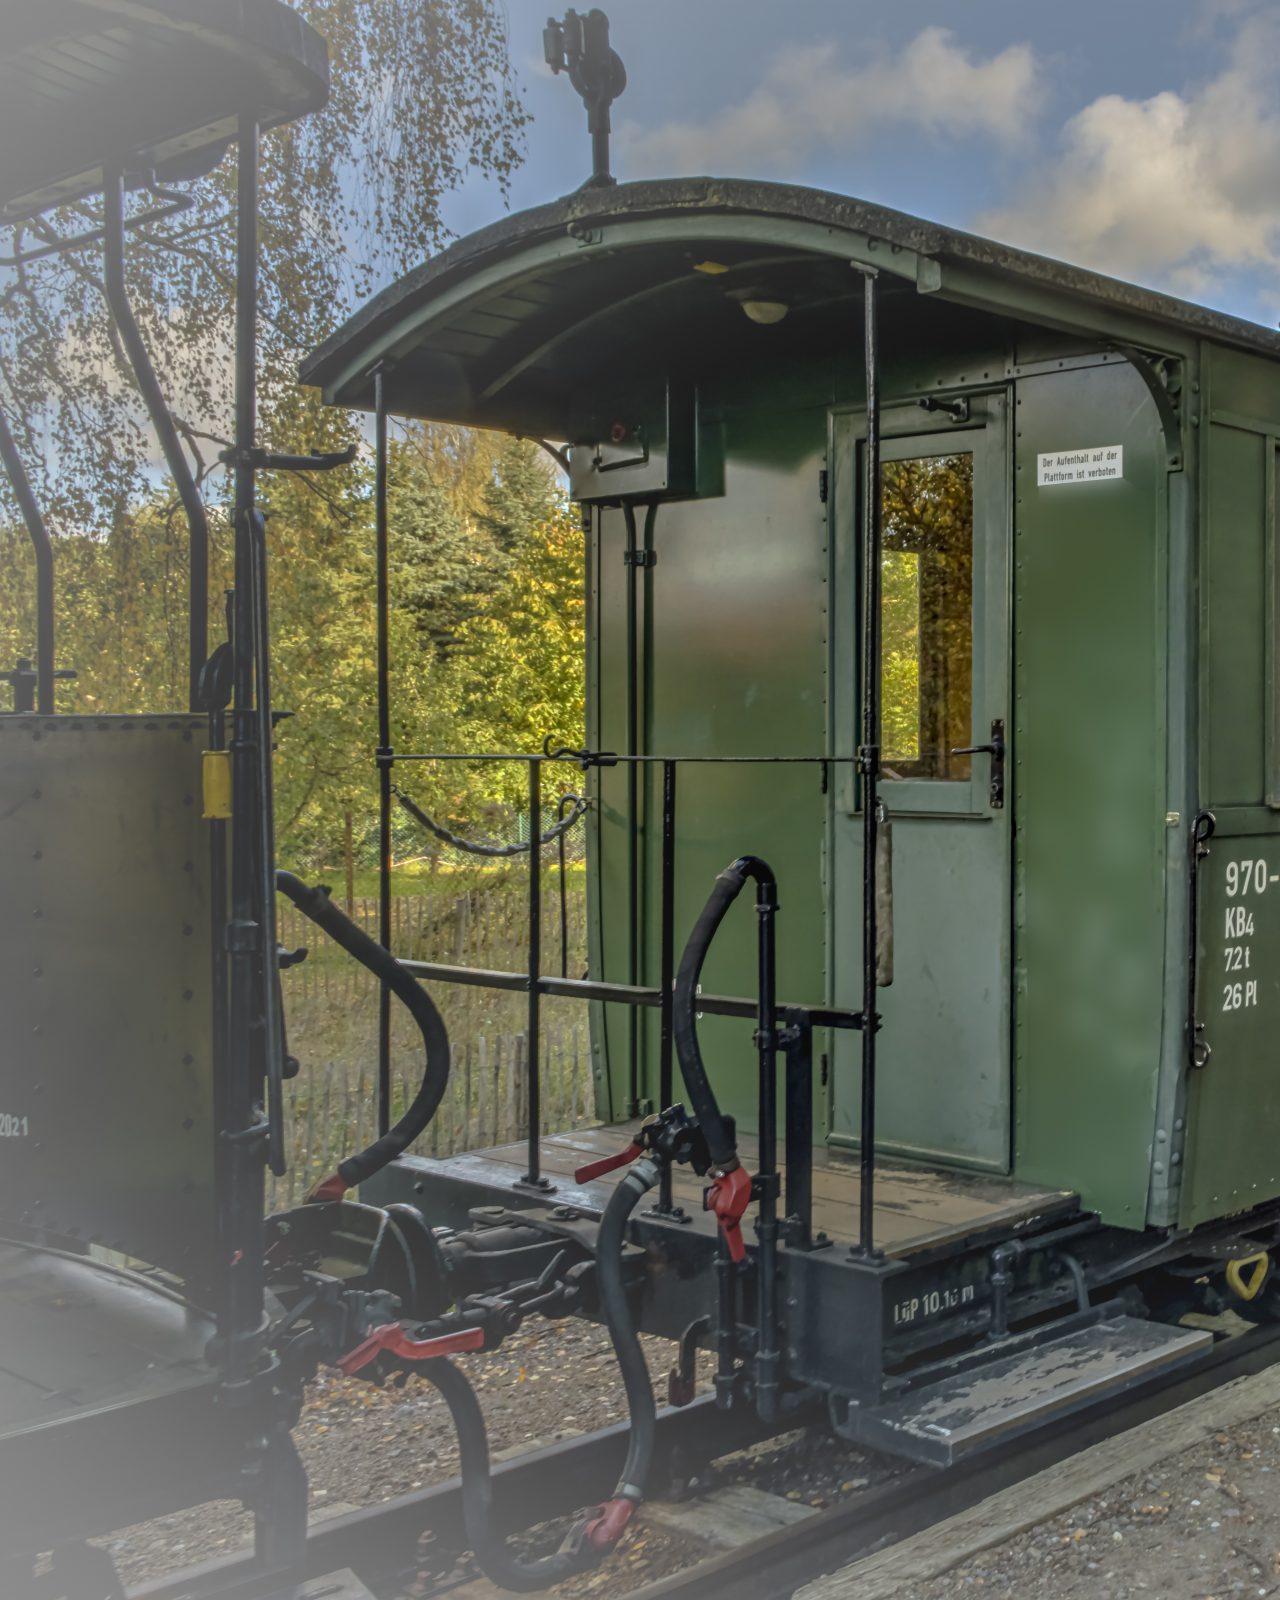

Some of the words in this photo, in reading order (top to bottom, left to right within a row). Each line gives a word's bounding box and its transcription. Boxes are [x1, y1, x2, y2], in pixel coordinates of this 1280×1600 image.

[1042, 458, 1053, 468] Der
[1056, 454, 1089, 466] Aufenthalt
[1092, 452, 1103, 462] auf
[1106, 450, 1117, 460] der
[1044, 472, 1073, 482] Plattform
[1076, 468, 1085, 479] ist
[1088, 467, 1116, 478] verboten
[1225, 906, 1254, 939] KB4
[1244, 946, 1250, 968] t
[1222, 982, 1242, 1011] 26
